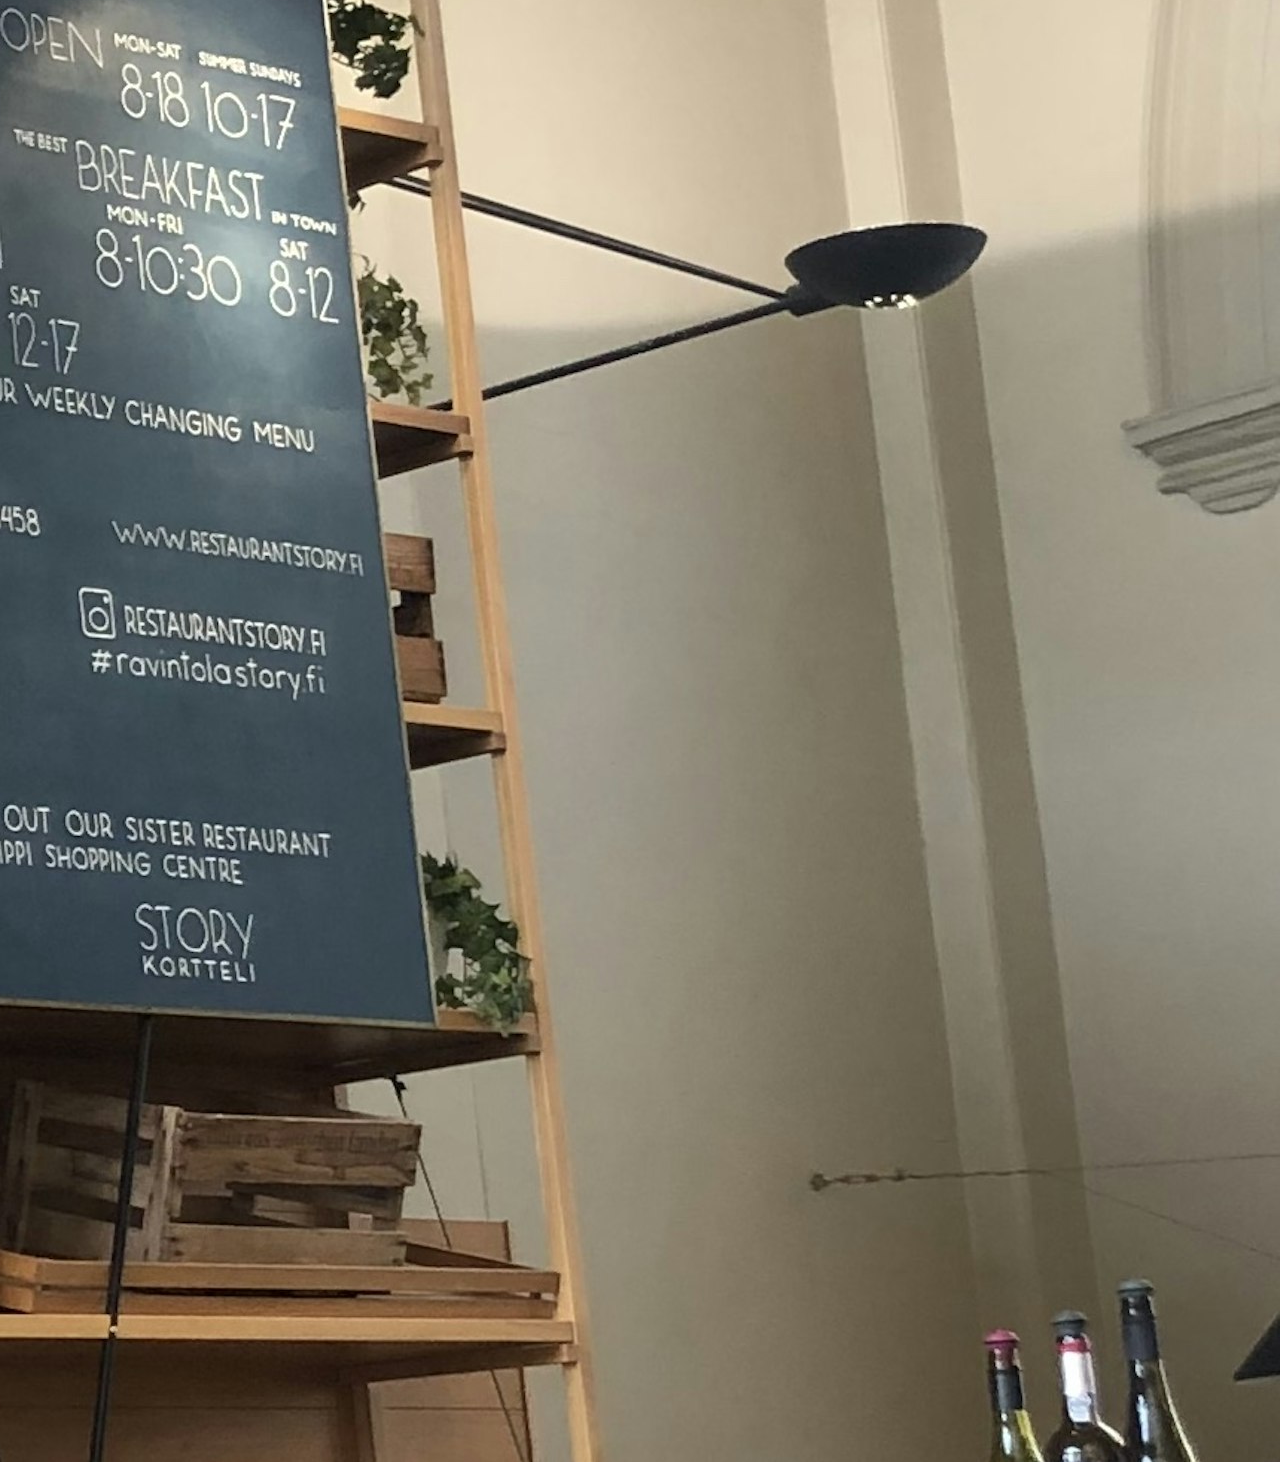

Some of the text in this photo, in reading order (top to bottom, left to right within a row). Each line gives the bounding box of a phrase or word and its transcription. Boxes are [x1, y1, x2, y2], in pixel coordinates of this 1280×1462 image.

[0, 7, 105, 69] OPEN
[114, 33, 302, 88] MON-SAT SUMMER SUNDAYS
[121, 63, 295, 150] 8-18 10-17
[13, 127, 337, 236] THE BEST BREAKFAST IN TOWN
[106, 203, 309, 261] MON-FRI SAT
[9, 286, 41, 308] SAT
[96, 228, 340, 325] 8-10:30 8-12
[7, 312, 80, 375] 12-17
[25, 382, 116, 420] WEEKLY
[125, 400, 242, 443] CHANGING
[253, 421, 315, 453] MENU
[111, 520, 365, 577] WWW.RESTAURANTSTORY.FI
[123, 605, 327, 657] RESTAURANTSTORY.FI
[91, 648, 326, 701] #ravintolastory.fi
[3, 804, 50, 834] OUT
[65, 809, 115, 839] OUR
[125, 817, 197, 847] SISTER
[203, 822, 331, 858] RESTAURANT
[45, 844, 152, 877] SHOPPING
[163, 854, 243, 886] CENTRE
[134, 903, 255, 960] STORY
[142, 955, 257, 984] KORTTELI
